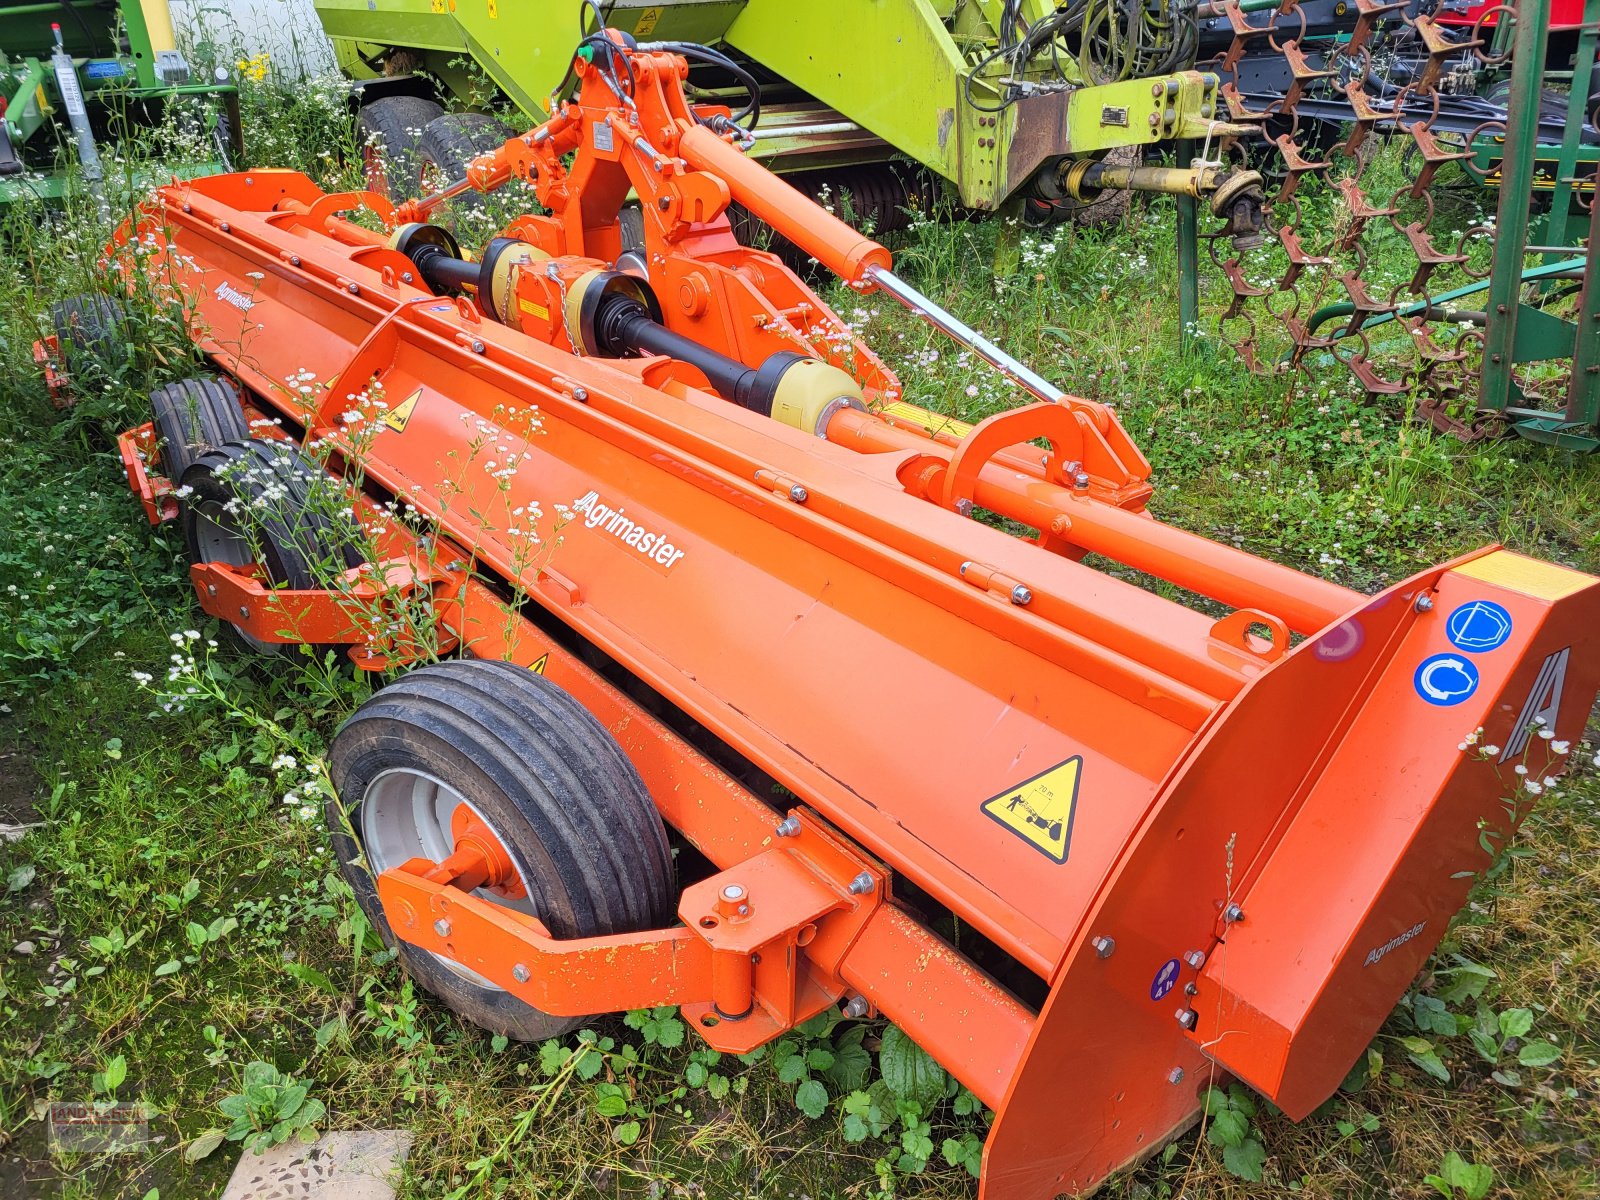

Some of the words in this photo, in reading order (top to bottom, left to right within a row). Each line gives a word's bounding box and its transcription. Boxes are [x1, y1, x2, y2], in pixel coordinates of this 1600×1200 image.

[214, 281, 256, 312] Agrimaster
[571, 490, 685, 568] Agrimaster
[1039, 784, 1048, 793] 70
[1363, 919, 1429, 967] Agrimaster
